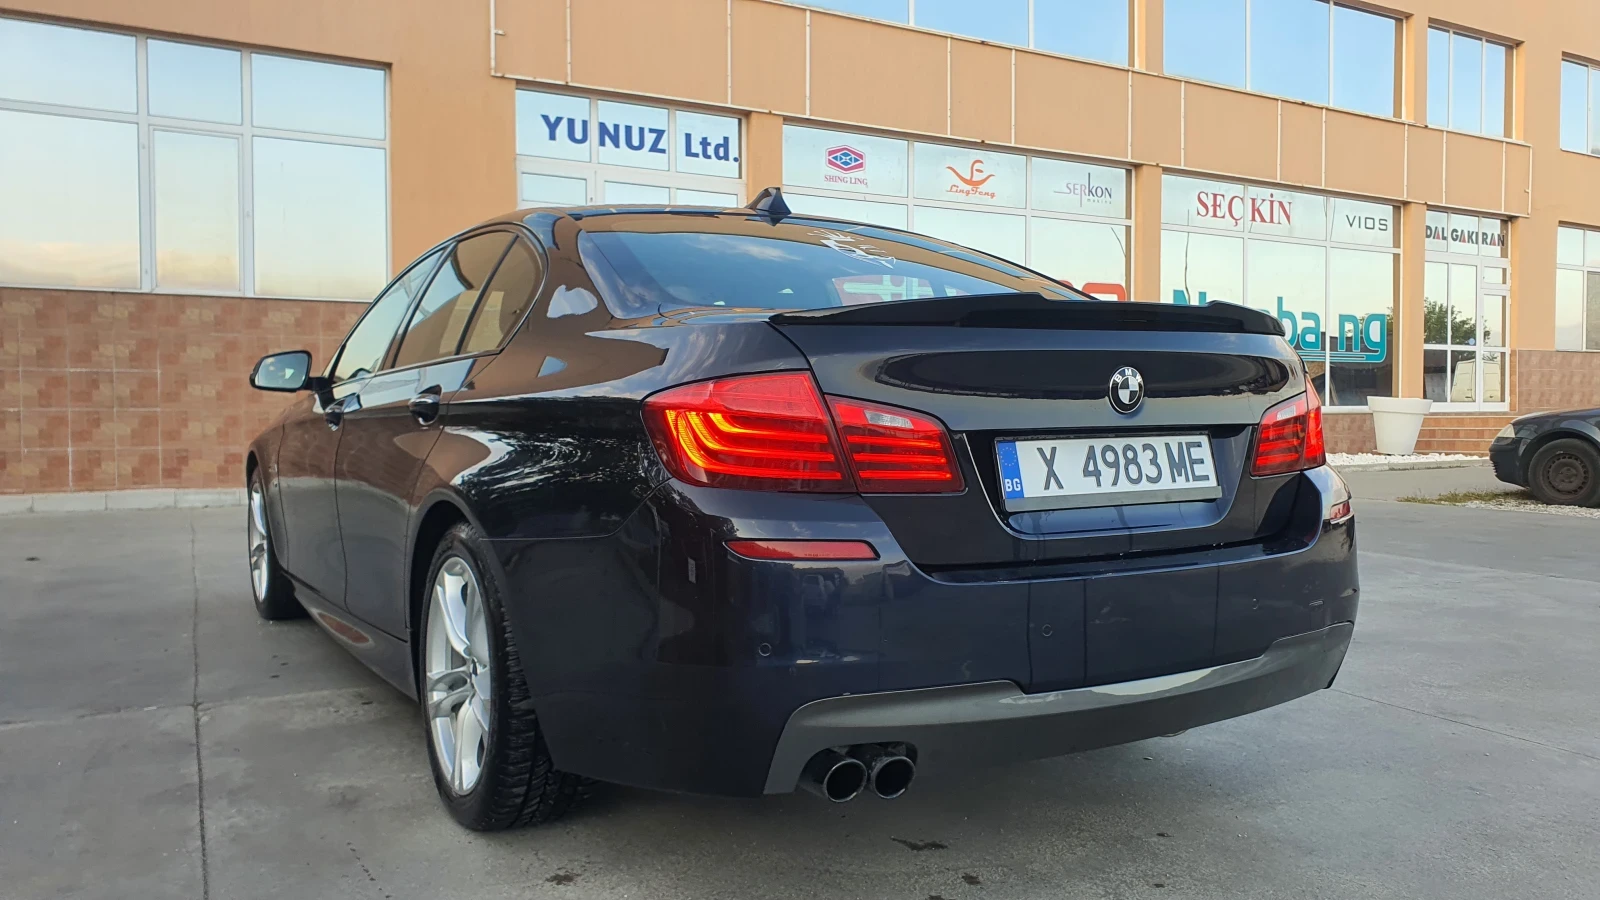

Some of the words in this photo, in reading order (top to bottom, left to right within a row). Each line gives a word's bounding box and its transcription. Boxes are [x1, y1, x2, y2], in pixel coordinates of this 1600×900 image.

[541, 114, 667, 154] YUNUZ
[684, 132, 740, 163] Ltd.
[824, 174, 848, 184] SHING
[849, 176, 868, 186] LING
[1196, 191, 1293, 227] SEÇKİN
[1345, 213, 1389, 232] VIOS
[1113, 368, 1143, 383] BMW
[1036, 446, 1064, 491] X
[1082, 443, 1163, 488] 4983
[1164, 441, 1210, 484] ME
[1004, 478, 1021, 492] BG
